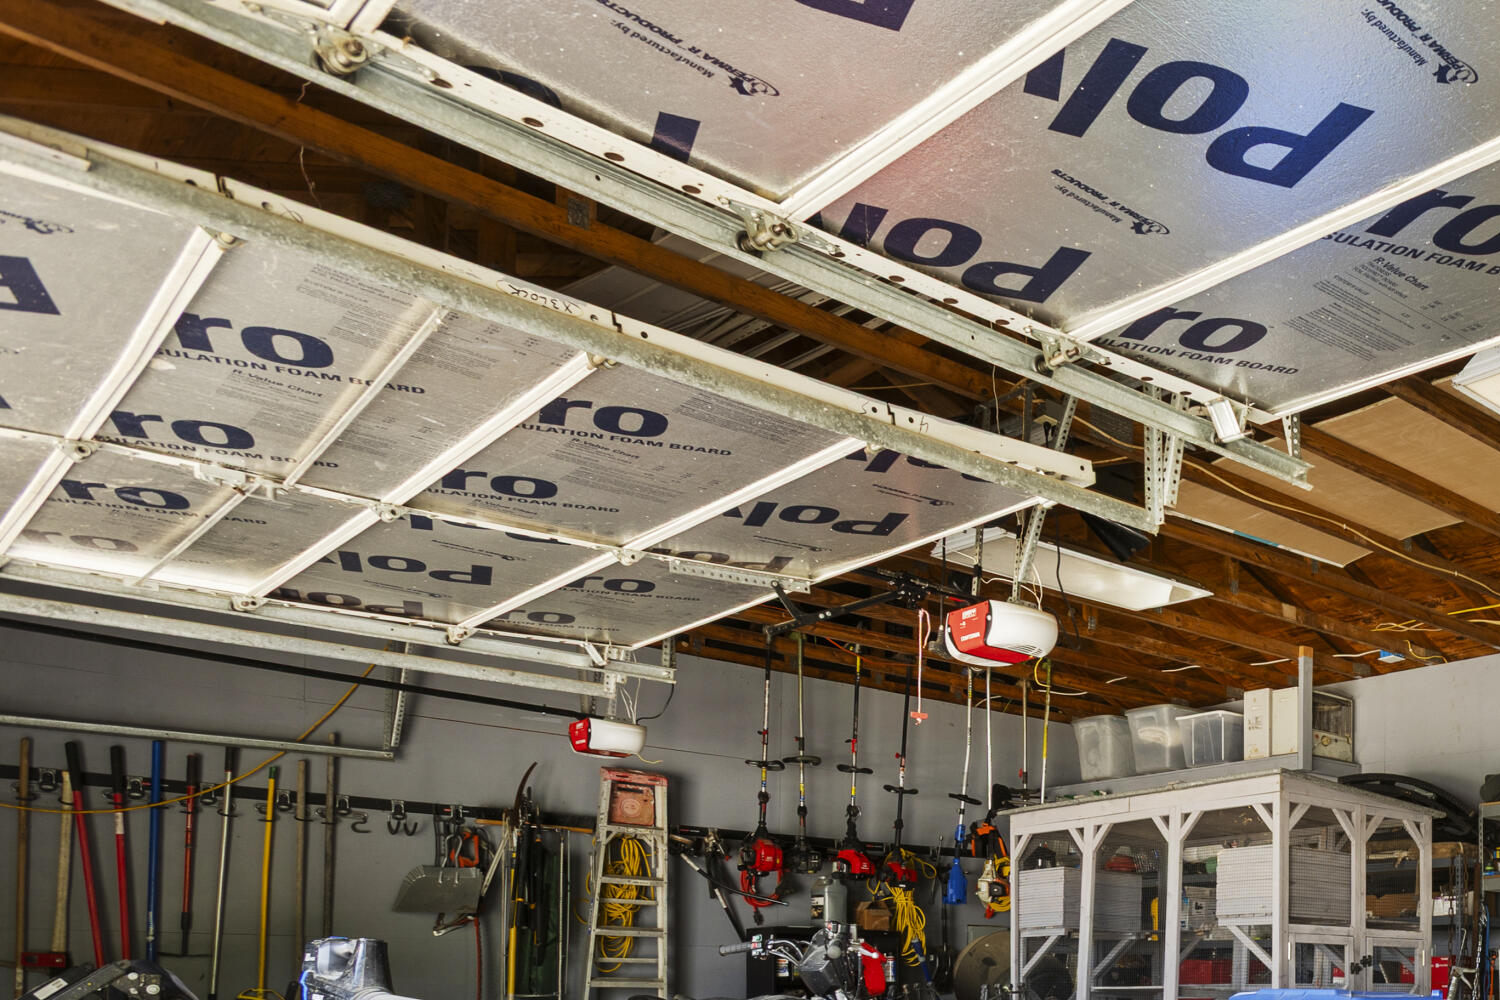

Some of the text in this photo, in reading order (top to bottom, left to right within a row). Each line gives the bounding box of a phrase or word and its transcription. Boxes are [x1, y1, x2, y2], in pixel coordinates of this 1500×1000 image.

[1361, 8, 1428, 66] Manufactured by:
[630, 31, 715, 79] Manufactured
[702, 52, 754, 83] PERMA
[1428, 40, 1465, 70] PERMA
[1050, 169, 1109, 201] PRODUCTS
[1067, 192, 1123, 223] Manufactured
[1119, 205, 1154, 226] PERMA
[805, 203, 1092, 304] Pol
[1425, 251, 1488, 272] FOAM
[1404, 275, 1430, 291] Chart
[174, 312, 334, 369] ro
[1118, 307, 1268, 354] ro
[275, 366, 341, 383] FOAM
[1178, 351, 1234, 366] FOAM
[1236, 360, 1299, 376] BOARD
[109, 410, 255, 450] ro
[539, 396, 669, 438] ro
[610, 435, 666, 449] FOAM
[669, 443, 732, 457] BOARD
[59, 479, 190, 510] ro
[441, 468, 558, 500] ro
[515, 496, 558, 508] FOAM
[562, 502, 620, 514] BOARD
[565, 576, 656, 594] ro
